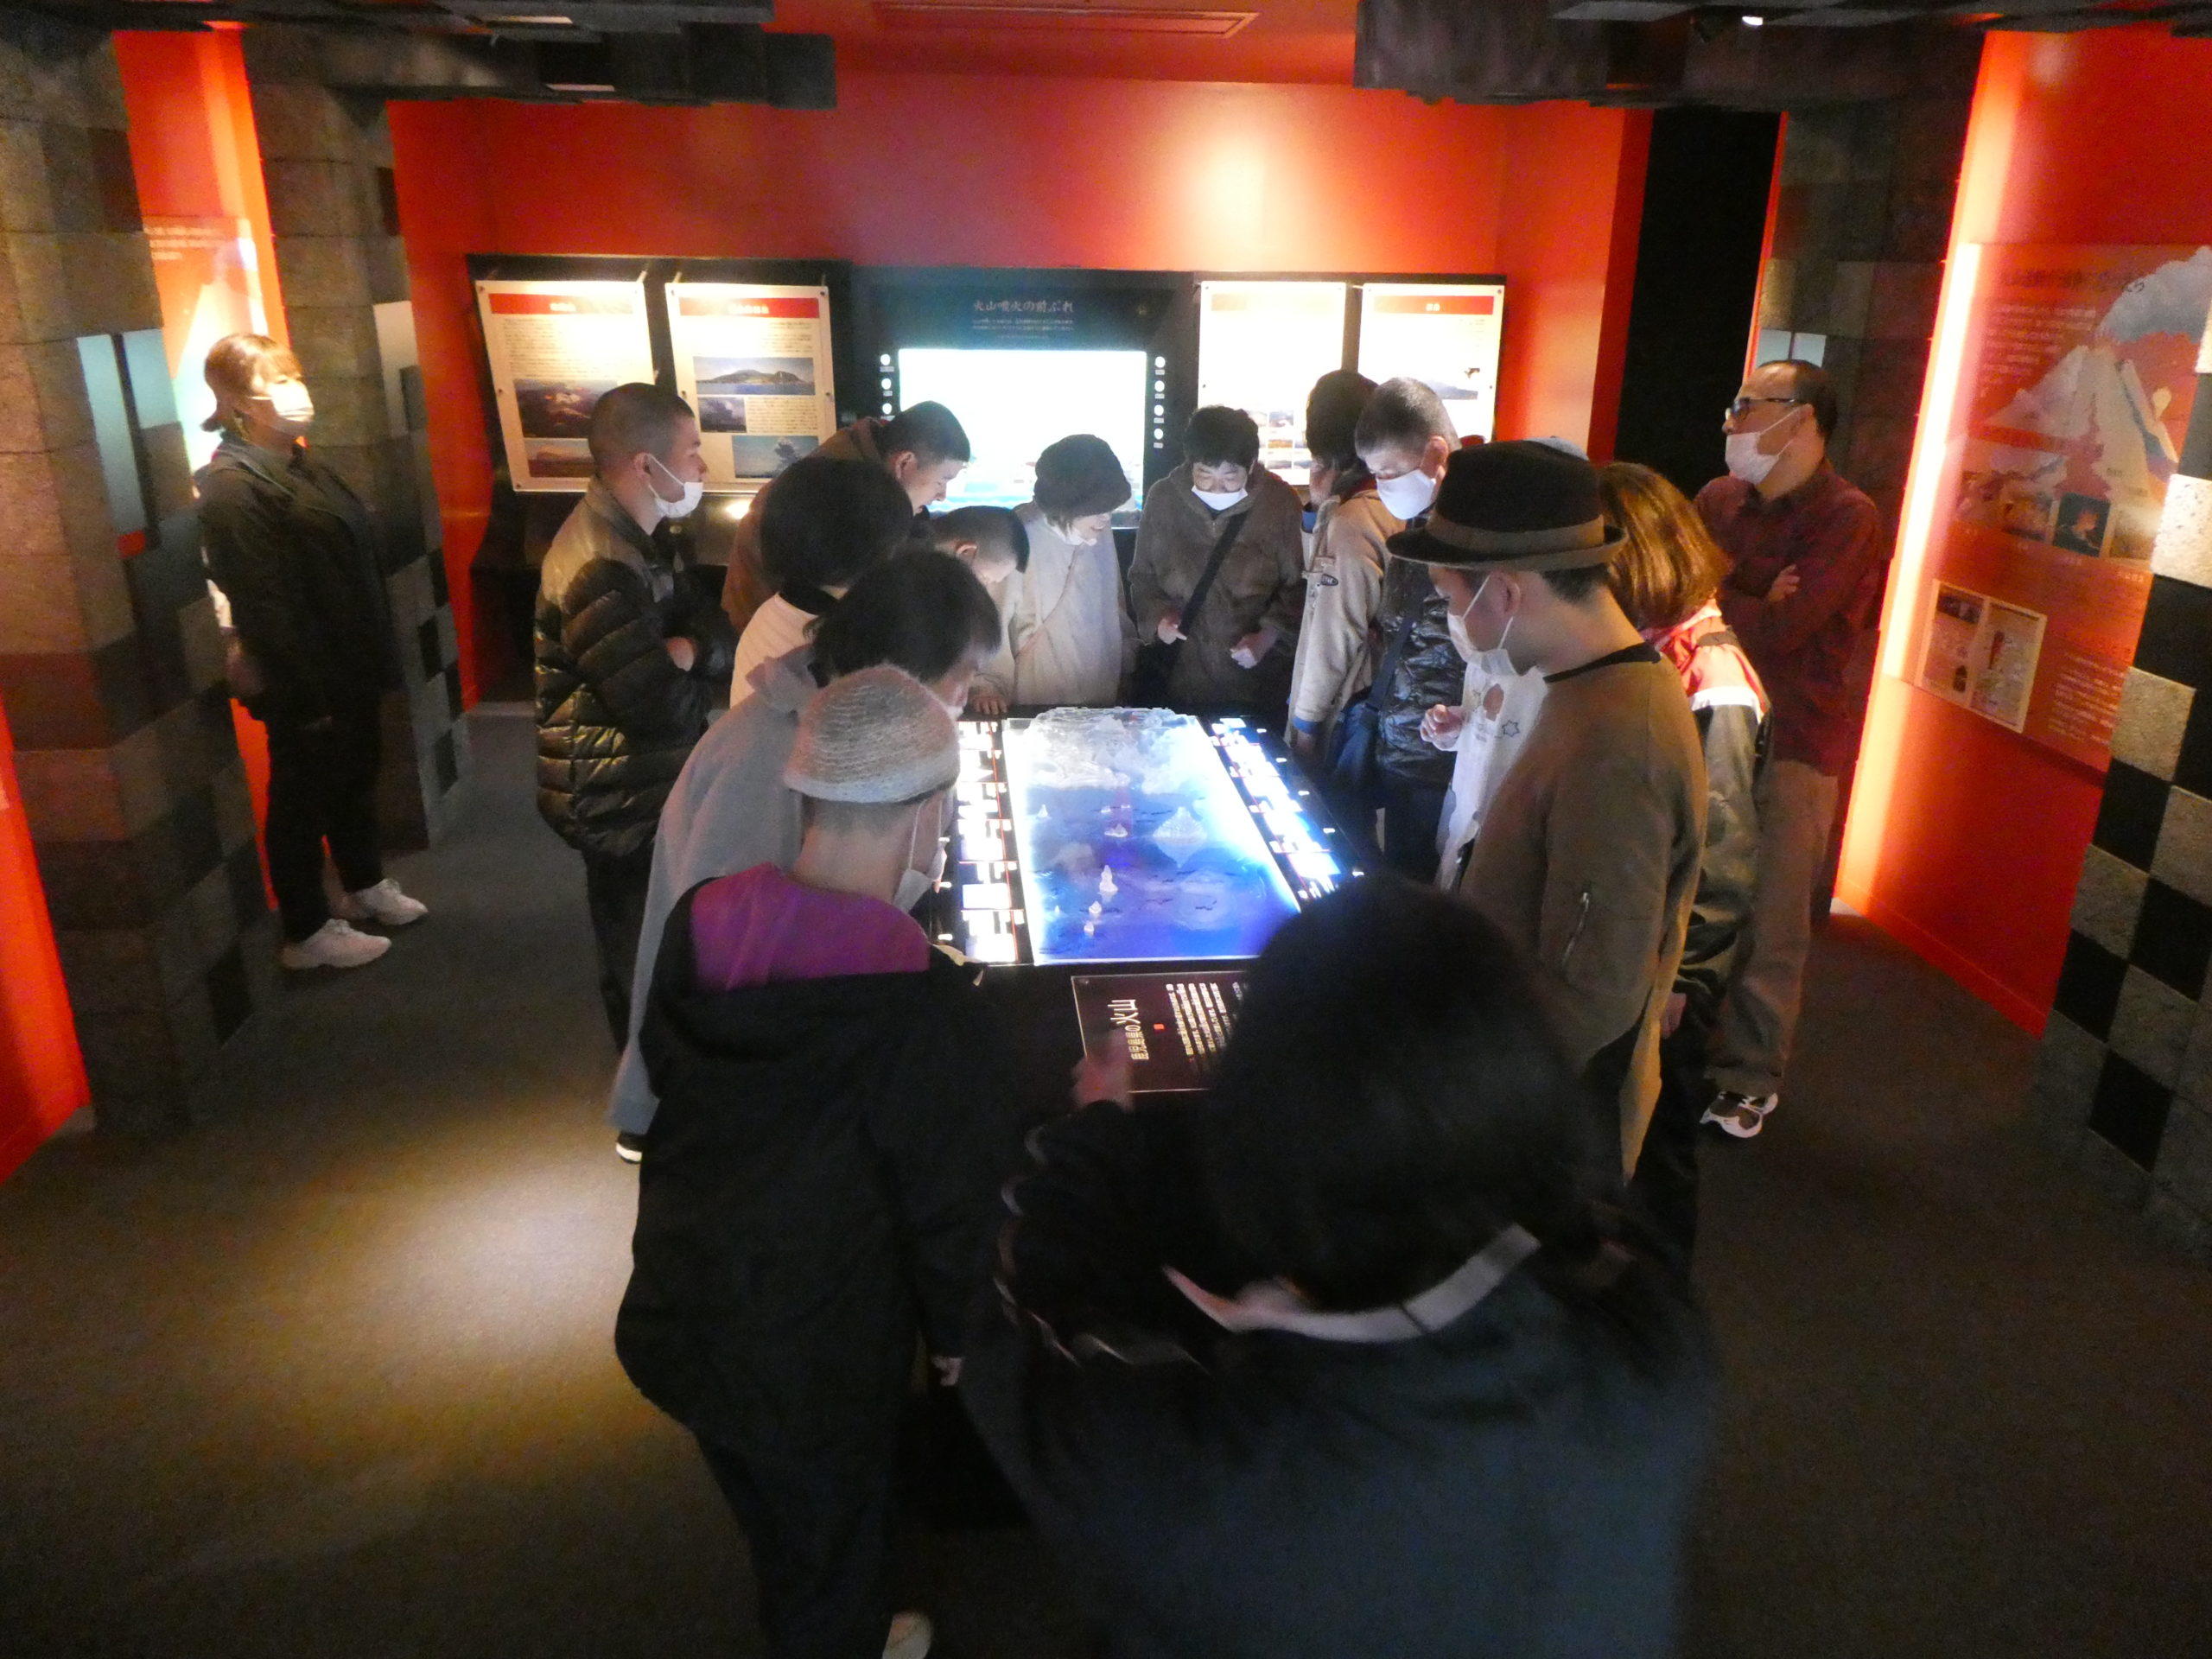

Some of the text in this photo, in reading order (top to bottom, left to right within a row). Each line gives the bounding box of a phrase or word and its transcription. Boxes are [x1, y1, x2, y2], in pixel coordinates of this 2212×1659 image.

[1107, 999, 1150, 1060] 鹿児島県の火山
